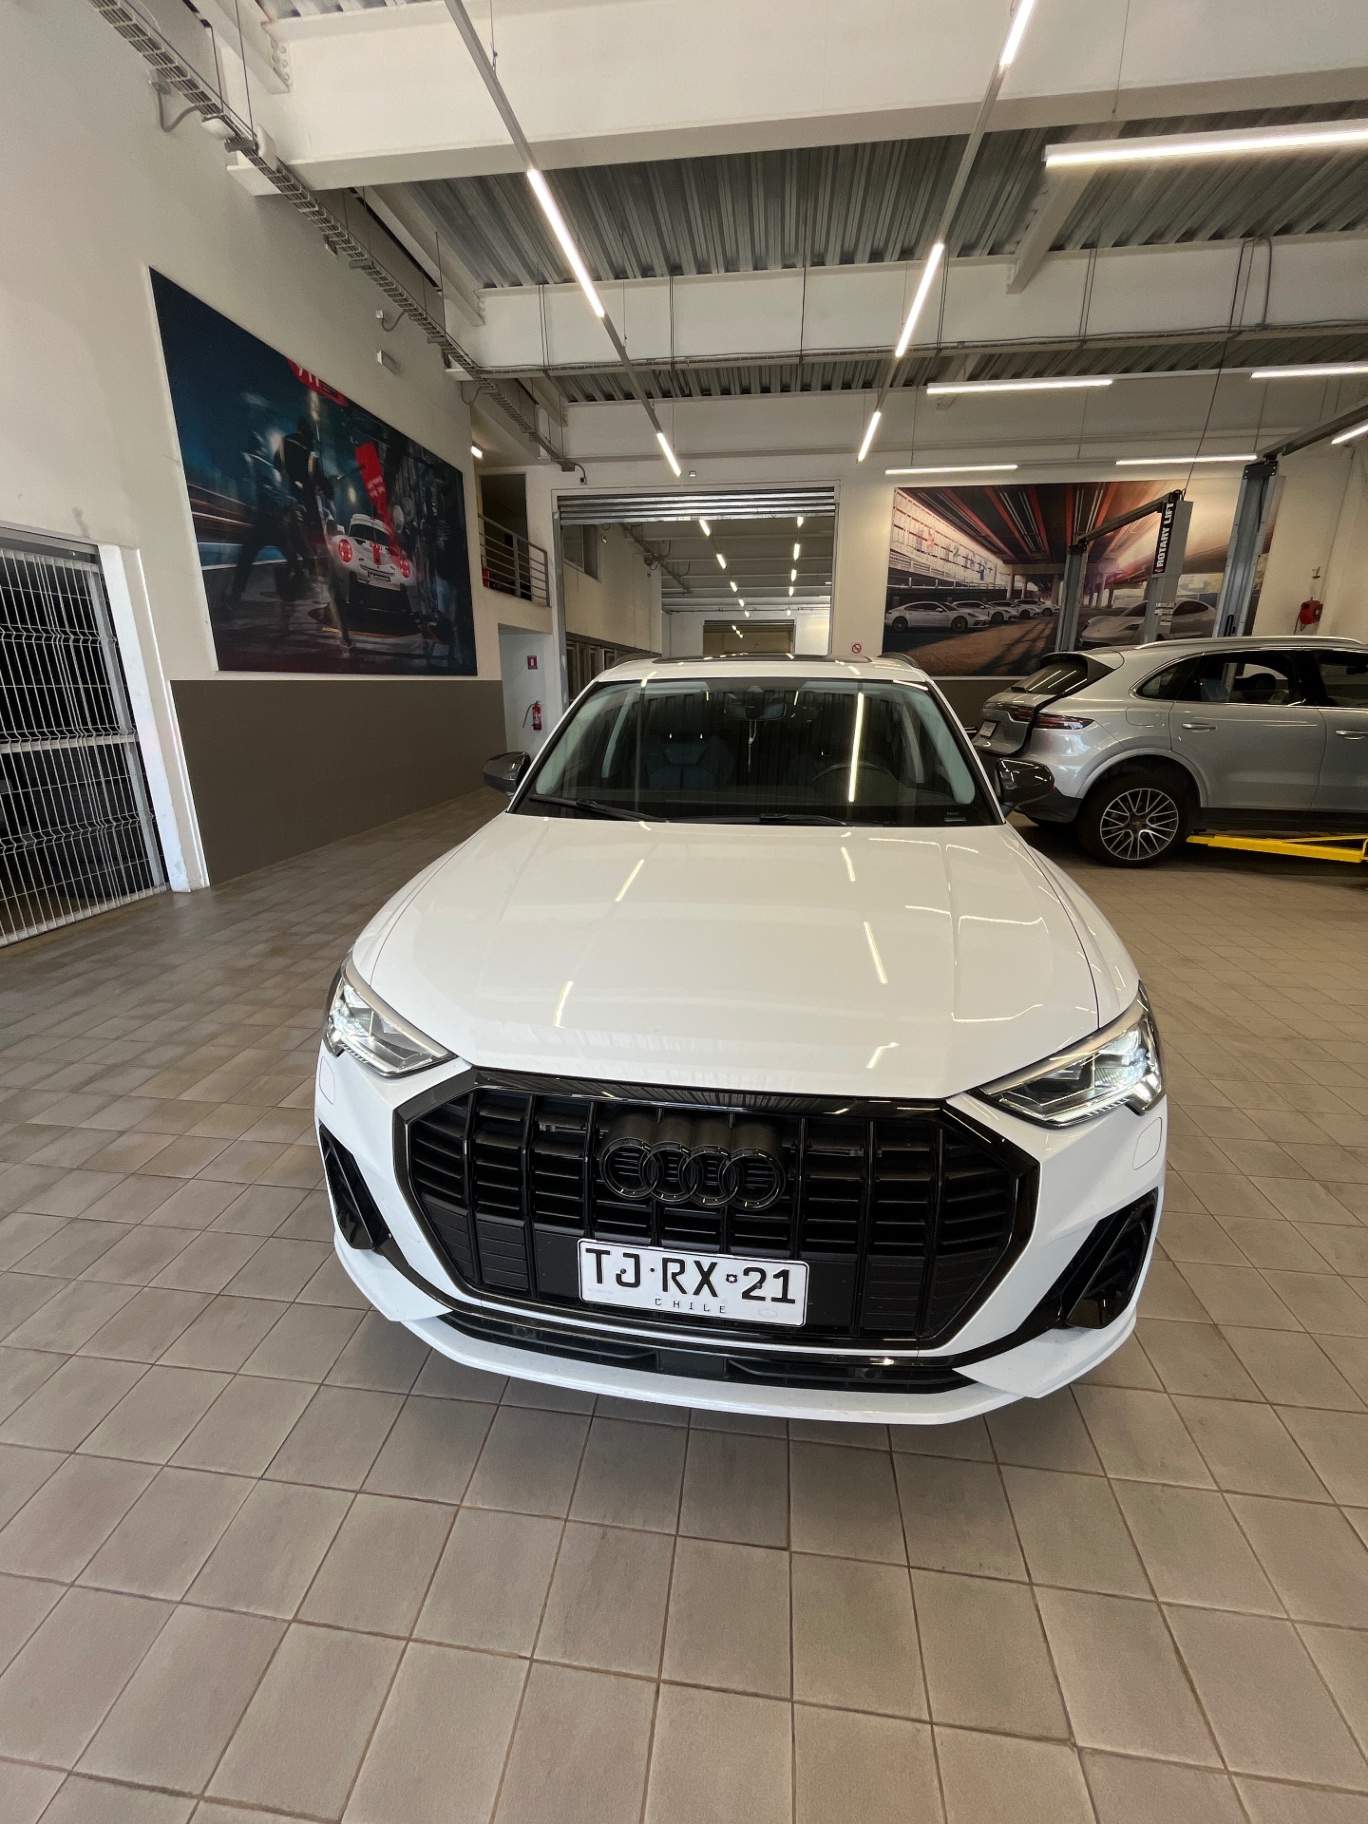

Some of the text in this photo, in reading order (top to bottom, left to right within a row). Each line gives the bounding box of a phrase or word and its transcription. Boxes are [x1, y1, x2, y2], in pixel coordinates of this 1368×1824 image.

[1156, 502, 1175, 568] ROTARY LIFT
[654, 1298, 728, 1314] CHILE
